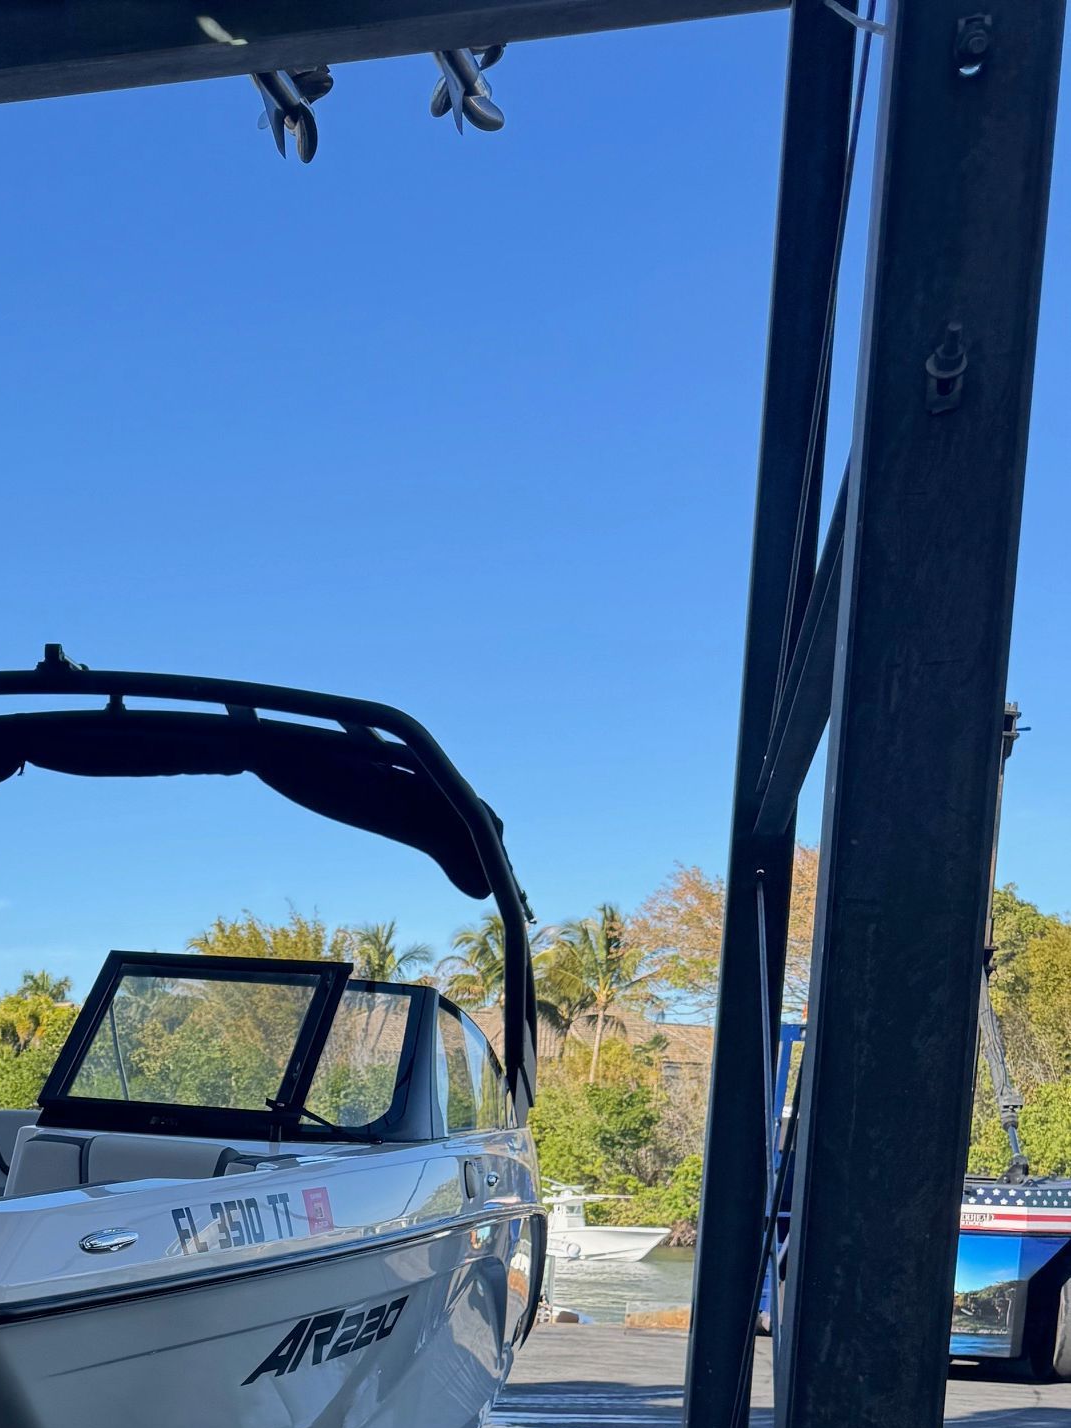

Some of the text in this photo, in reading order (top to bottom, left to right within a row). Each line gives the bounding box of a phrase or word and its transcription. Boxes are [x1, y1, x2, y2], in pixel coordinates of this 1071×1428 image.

[171, 1192, 294, 1257] FL 3510 TT
[240, 1294, 410, 1387] AR220
